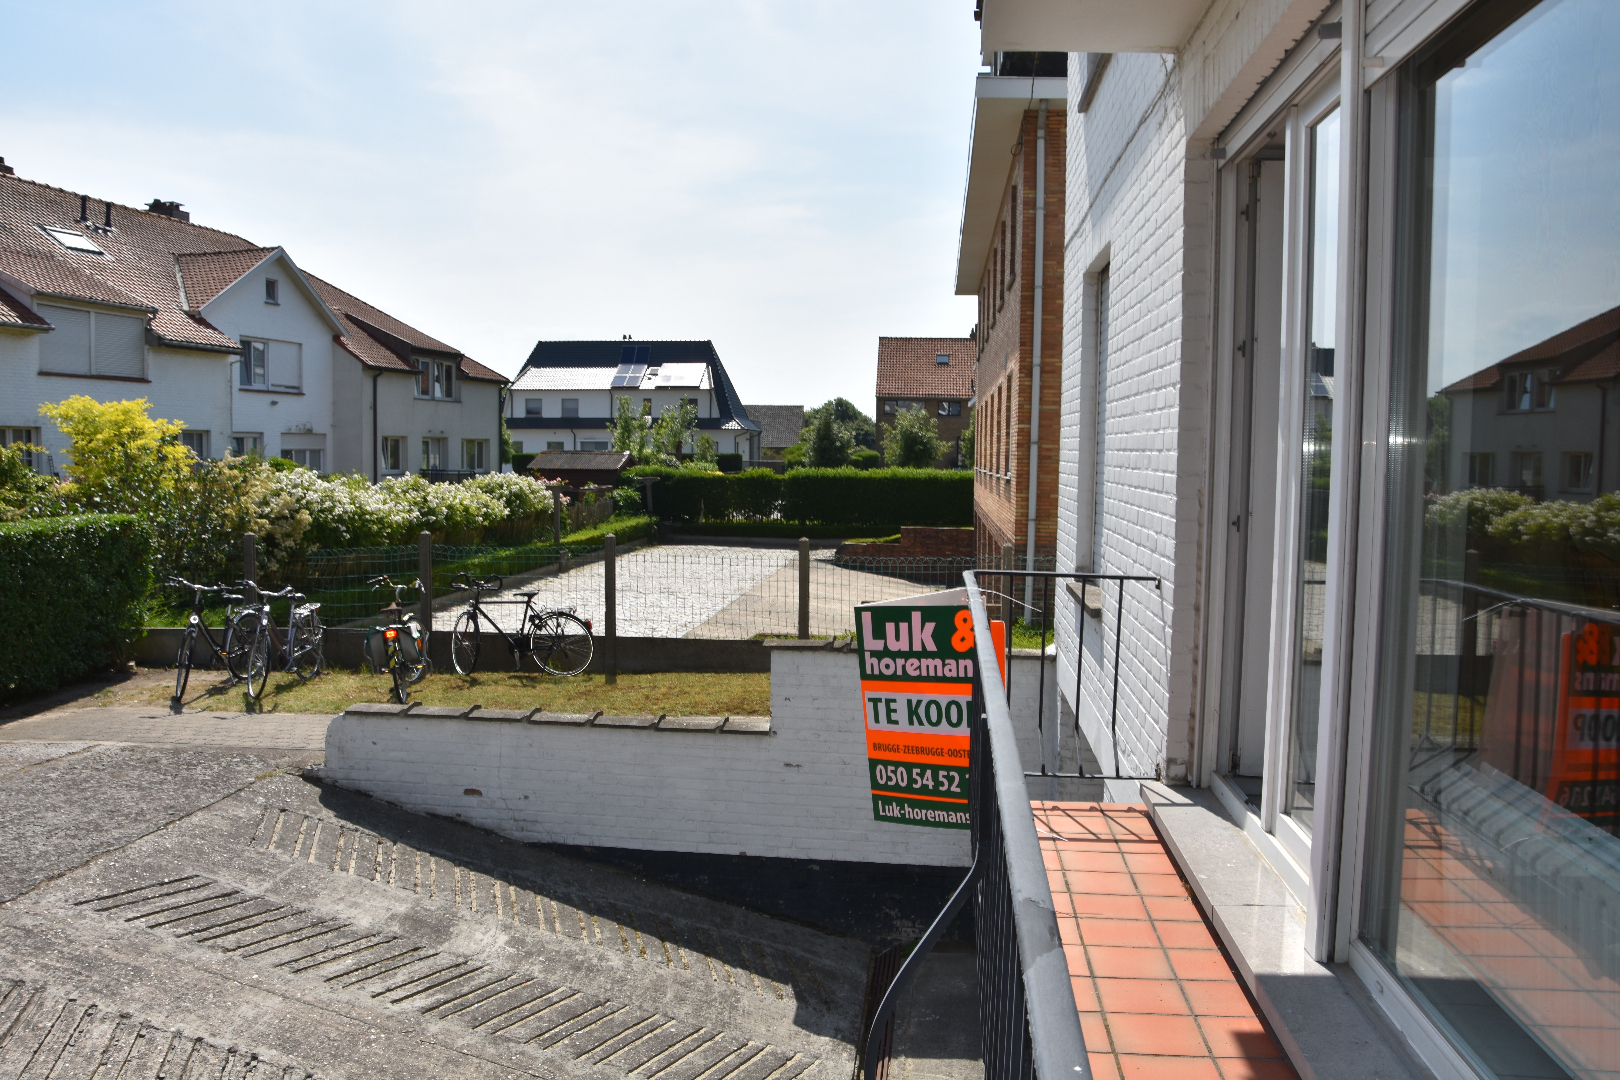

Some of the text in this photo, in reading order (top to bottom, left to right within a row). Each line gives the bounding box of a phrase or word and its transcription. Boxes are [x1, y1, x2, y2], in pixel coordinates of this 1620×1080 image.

[861, 609, 975, 653] Luk &
[864, 651, 973, 678] horeman
[868, 698, 899, 725] TE
[876, 764, 961, 793] 050 54 52
